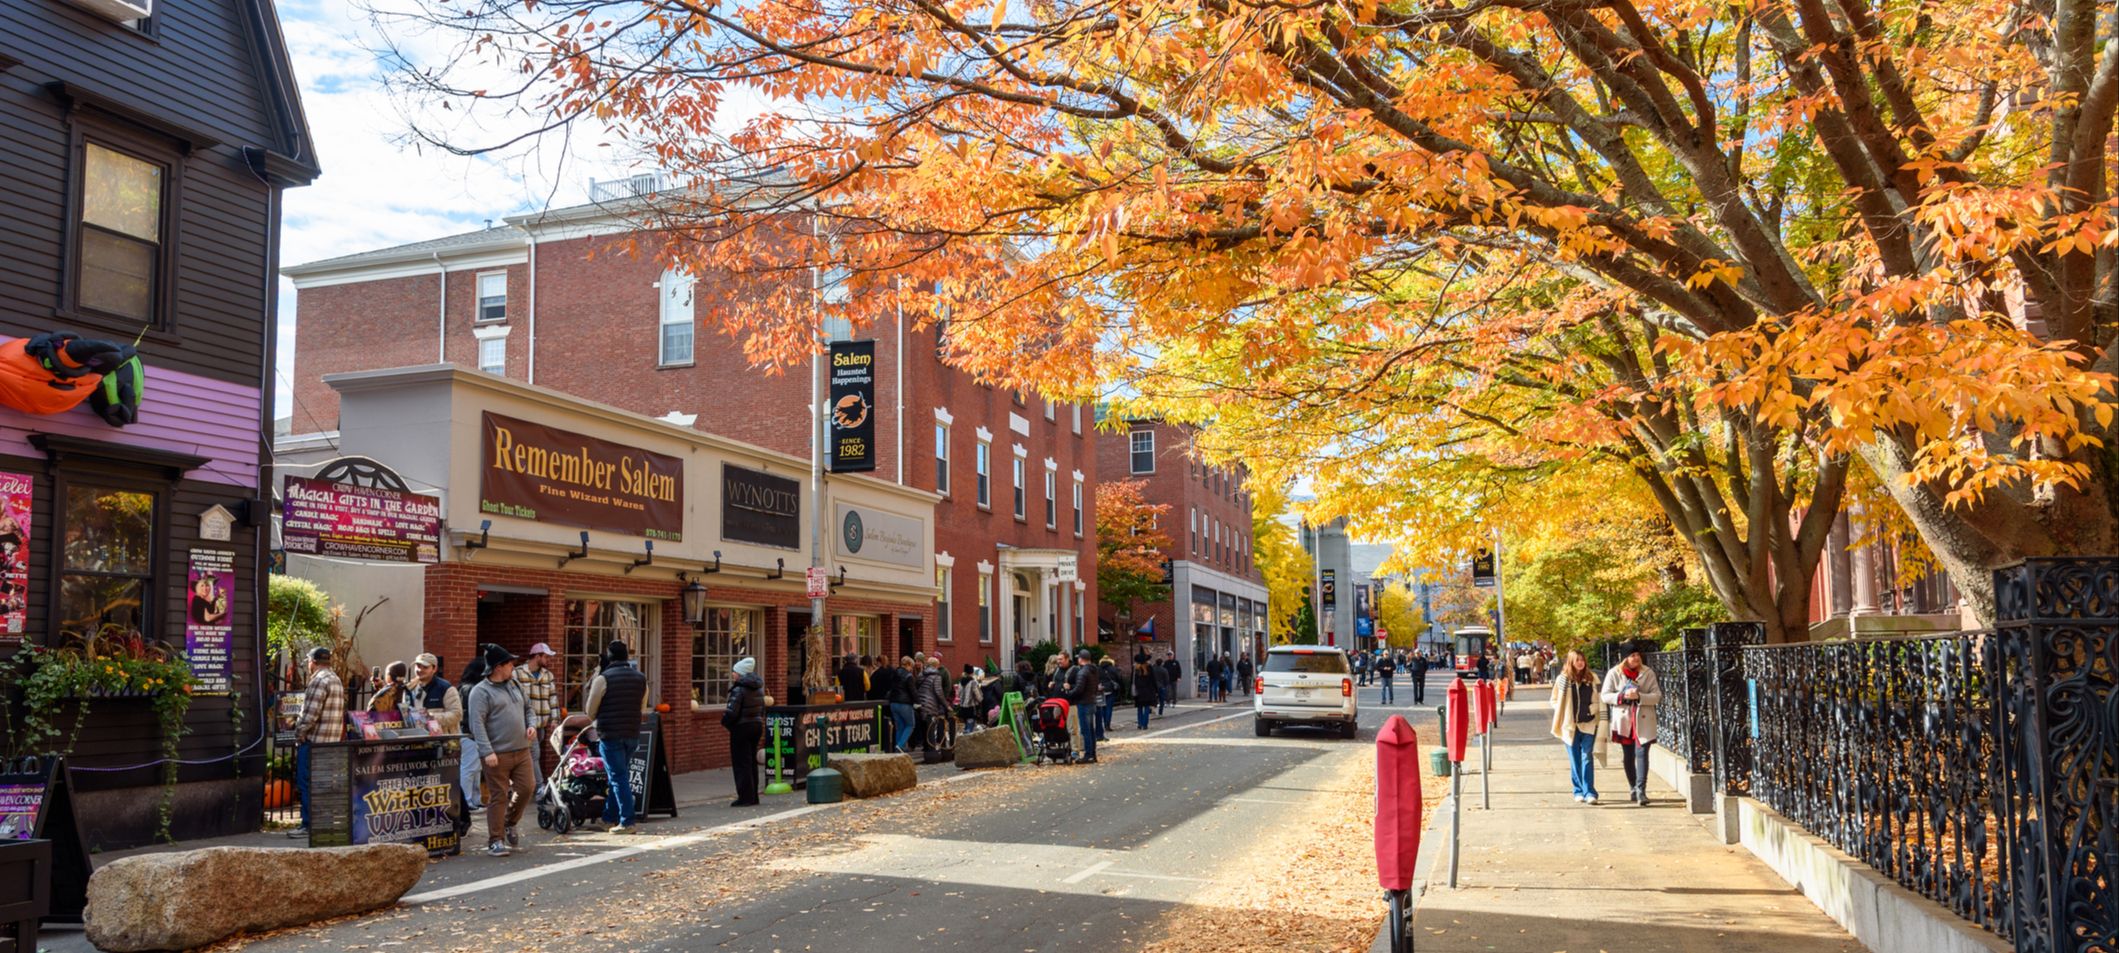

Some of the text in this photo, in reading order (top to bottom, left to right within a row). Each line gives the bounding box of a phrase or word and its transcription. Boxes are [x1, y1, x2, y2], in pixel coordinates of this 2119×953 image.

[833, 352, 871, 366] Salem
[837, 368, 867, 376] Haunted
[832, 376, 871, 385] Happenings
[839, 444, 865, 456] 1982
[493, 426, 676, 502] Remember Salem
[287, 483, 438, 517] MAGICAL GIFTS IN THE GARDEN
[354, 486, 376, 496] HAVEN
[376, 488, 401, 499] CORNER
[539, 484, 645, 511] Fine Wizard Wares
[727, 480, 797, 513] WYNOTTS
[295, 510, 339, 521] CANDLE MAGIC
[482, 499, 536, 519] Ghost Tour Tickets
[286, 520, 312, 528] CRYSTAL
[313, 522, 333, 531] MAGIC
[395, 521, 409, 529] LOVE
[410, 523, 426, 531] MAGIC
[324, 541, 408, 556] CROWHAVENCORNER.COM
[768, 727, 792, 737] TUR
[805, 723, 872, 748] GHST TOUR
[355, 766, 385, 775] SALEM
[430, 757, 460, 769] GARDEN
[377, 773, 440, 791] THE SALEM
[365, 806, 453, 837] WALK
